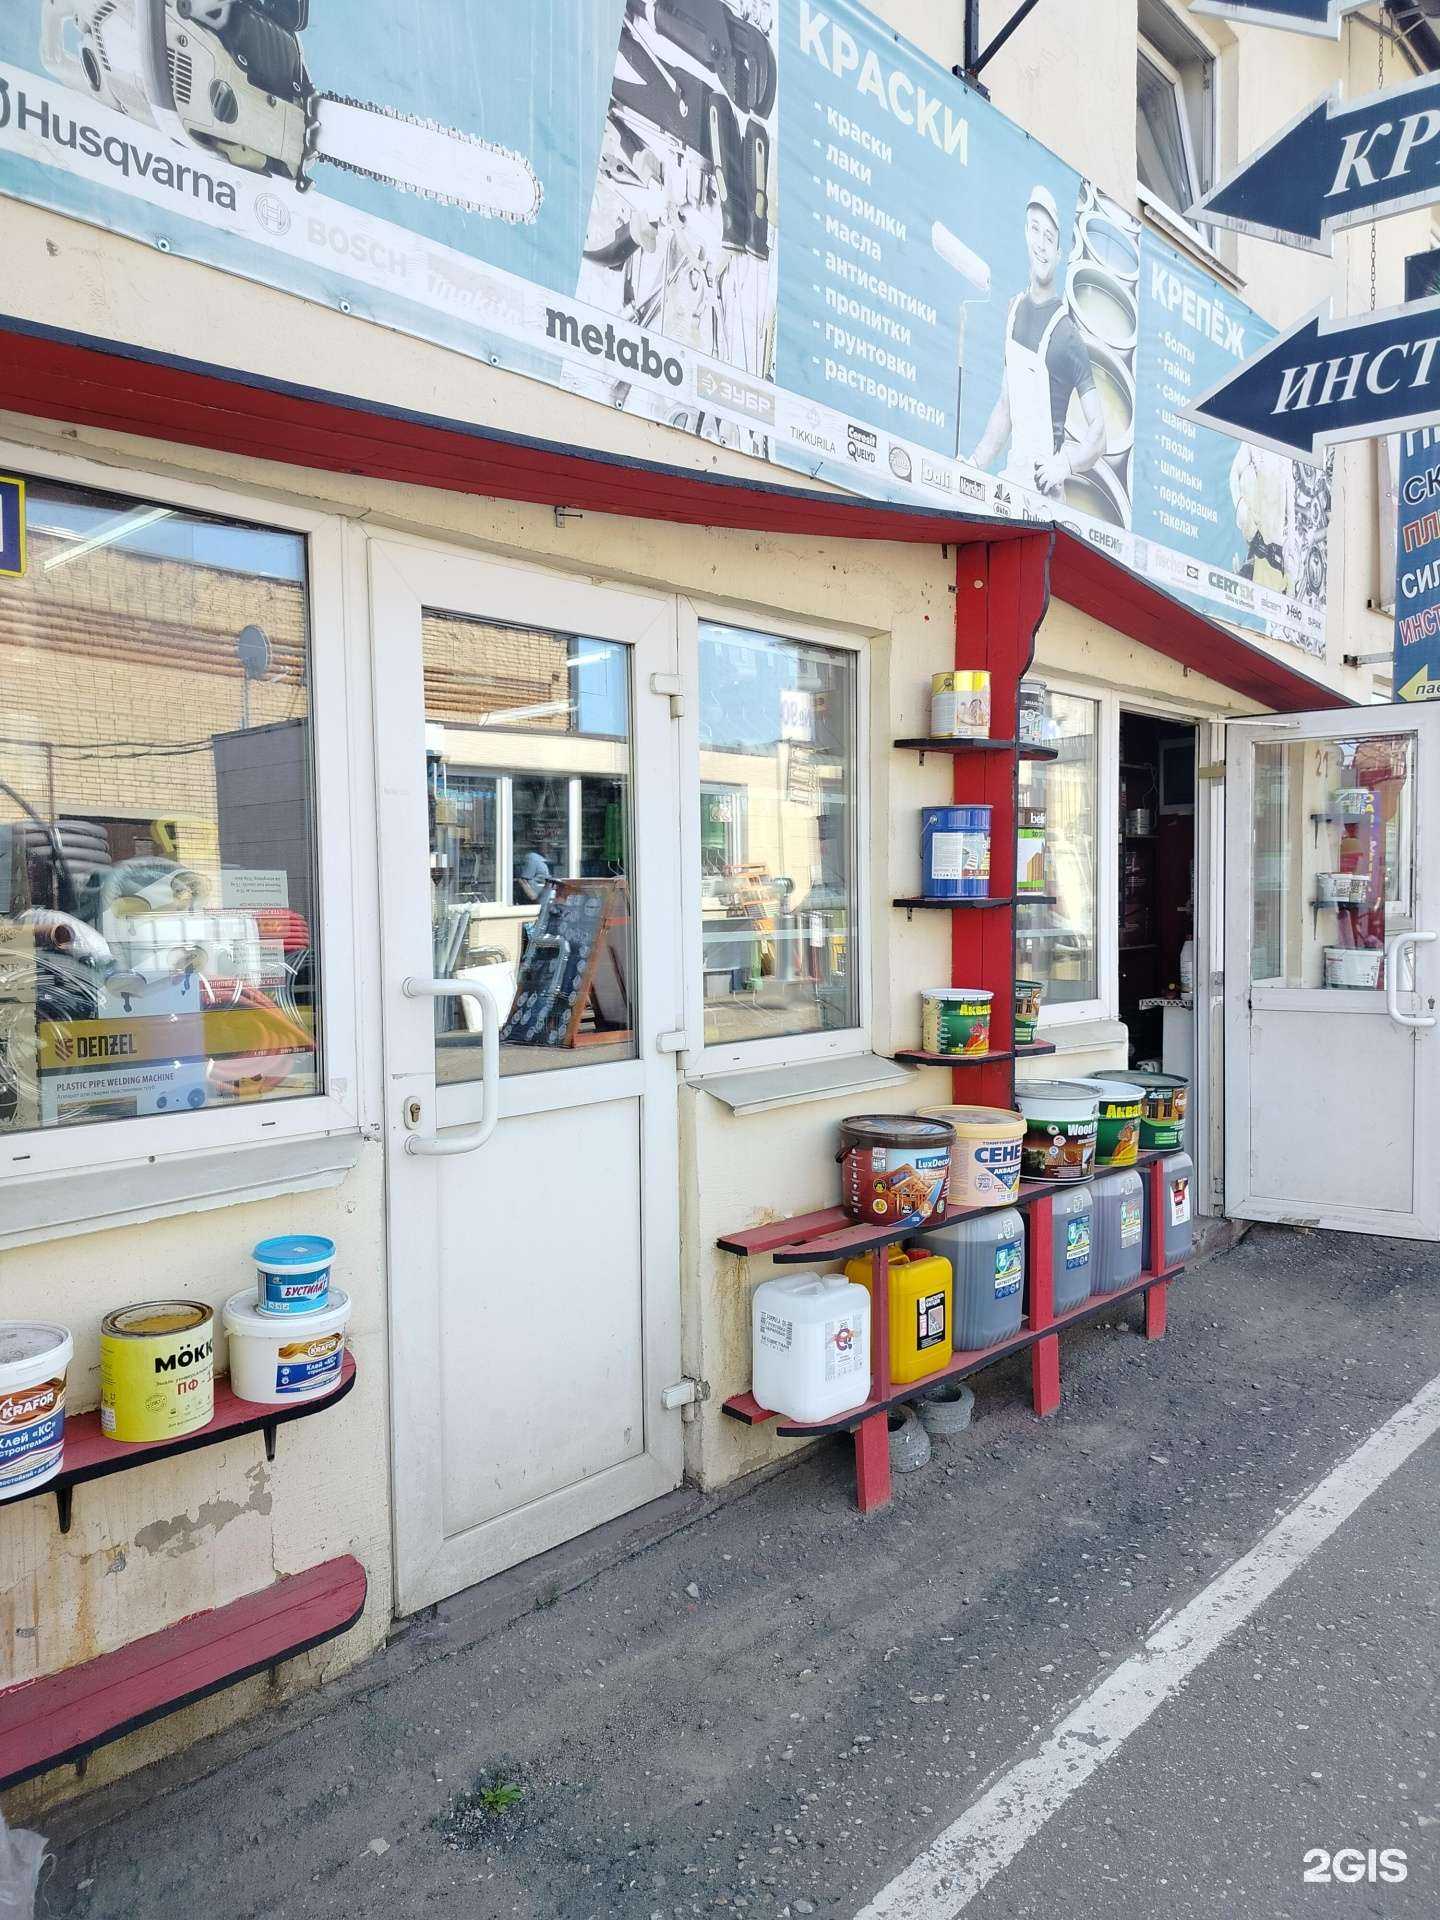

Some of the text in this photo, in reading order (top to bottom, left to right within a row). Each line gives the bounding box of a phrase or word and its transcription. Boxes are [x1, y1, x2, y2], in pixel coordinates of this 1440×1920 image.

[800, 7, 969, 167] КРАСКИ
[17, 90, 238, 212] Husqvarna
[826, 105, 892, 164] краски
[1324, 108, 1440, 199] КР
[826, 145, 872, 186] лаки
[826, 176, 907, 242] морилки
[306, 216, 407, 278] BOSCH
[825, 213, 882, 263] масла
[825, 252, 937, 326] антисептики
[1151, 261, 1246, 361] КРЕПЁЖ
[825, 288, 911, 346] пропитки
[545, 306, 684, 387] metabo
[825, 323, 917, 382] грунтовки
[1164, 331, 1195, 364] болты
[825, 359, 945, 429] растворители
[1164, 358, 1191, 386] гайки
[1162, 385, 1191, 408] само
[790, 426, 836, 456] TIKKURILA
[848, 441, 876, 463] QUELYD
[1161, 436, 1194, 464] гвозди
[1160, 459, 1203, 492] шпильки
[1158, 510, 1200, 540] такелаж
[1159, 485, 1218, 525] перфорация
[77, 1033, 138, 1058] DENZEL
[56, 1071, 175, 1092] PLASTIC PIPE WELDING MACHINE
[1067, 1121, 1092, 1137] Wood
